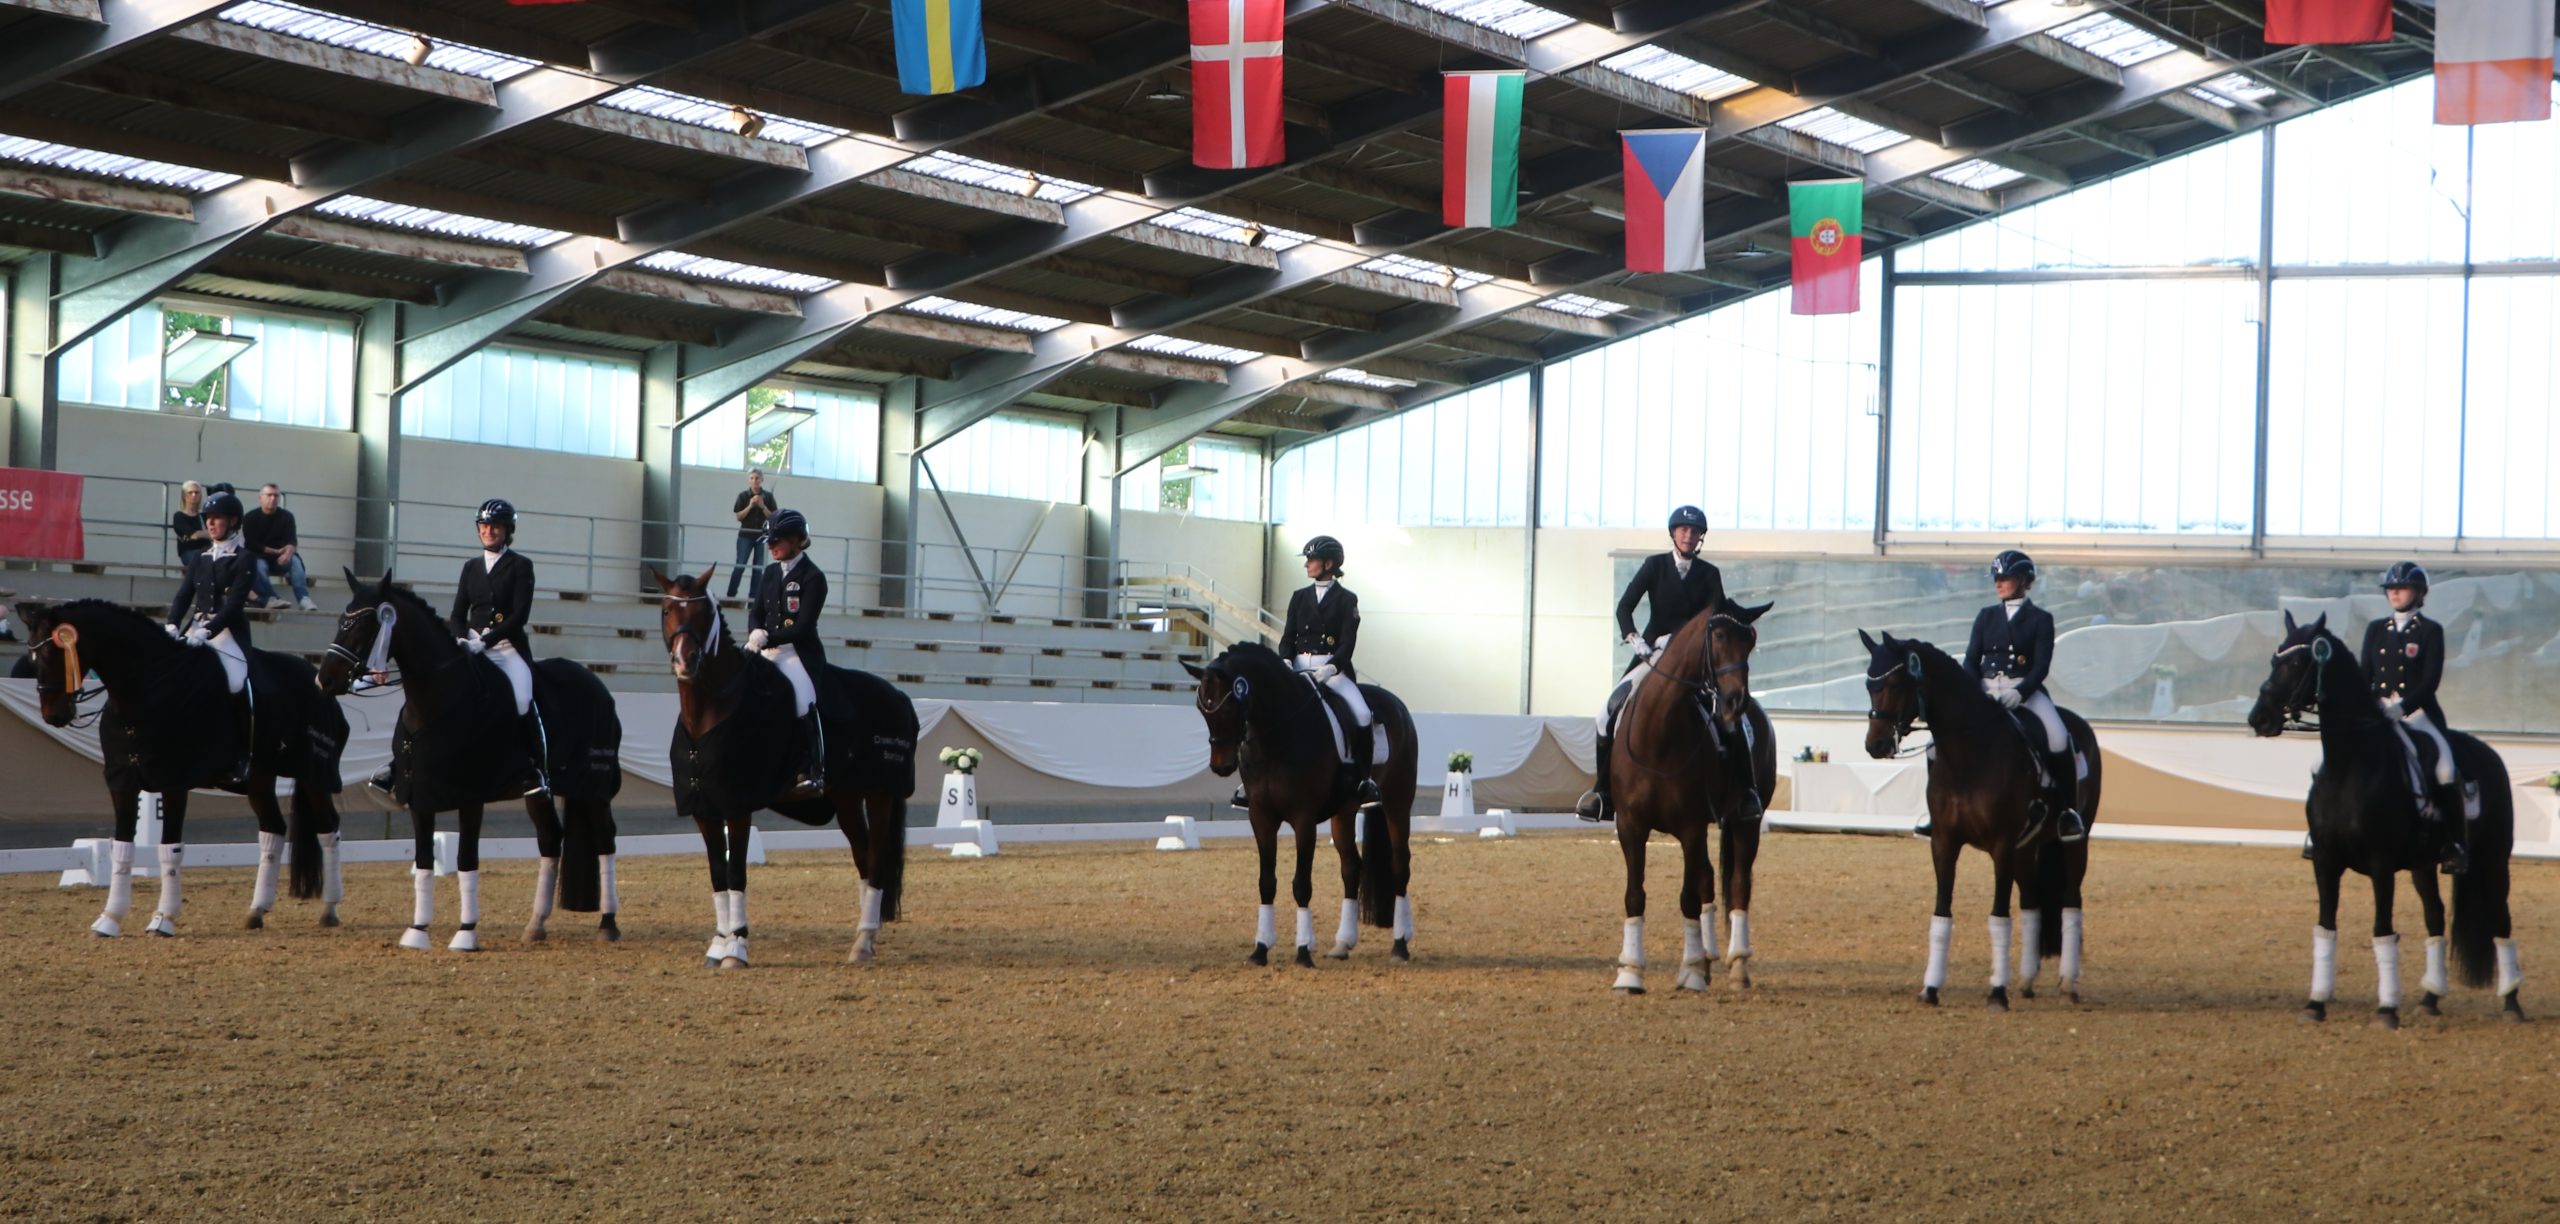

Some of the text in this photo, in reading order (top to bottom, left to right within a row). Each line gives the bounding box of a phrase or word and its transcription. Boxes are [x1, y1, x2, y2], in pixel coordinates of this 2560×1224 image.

[0, 489, 33, 511] sse
[947, 787, 958, 806] S
[967, 788, 974, 806] S
[1449, 783, 1458, 797] H
[1465, 784, 1471, 797] H
[156, 798, 164, 820] E
